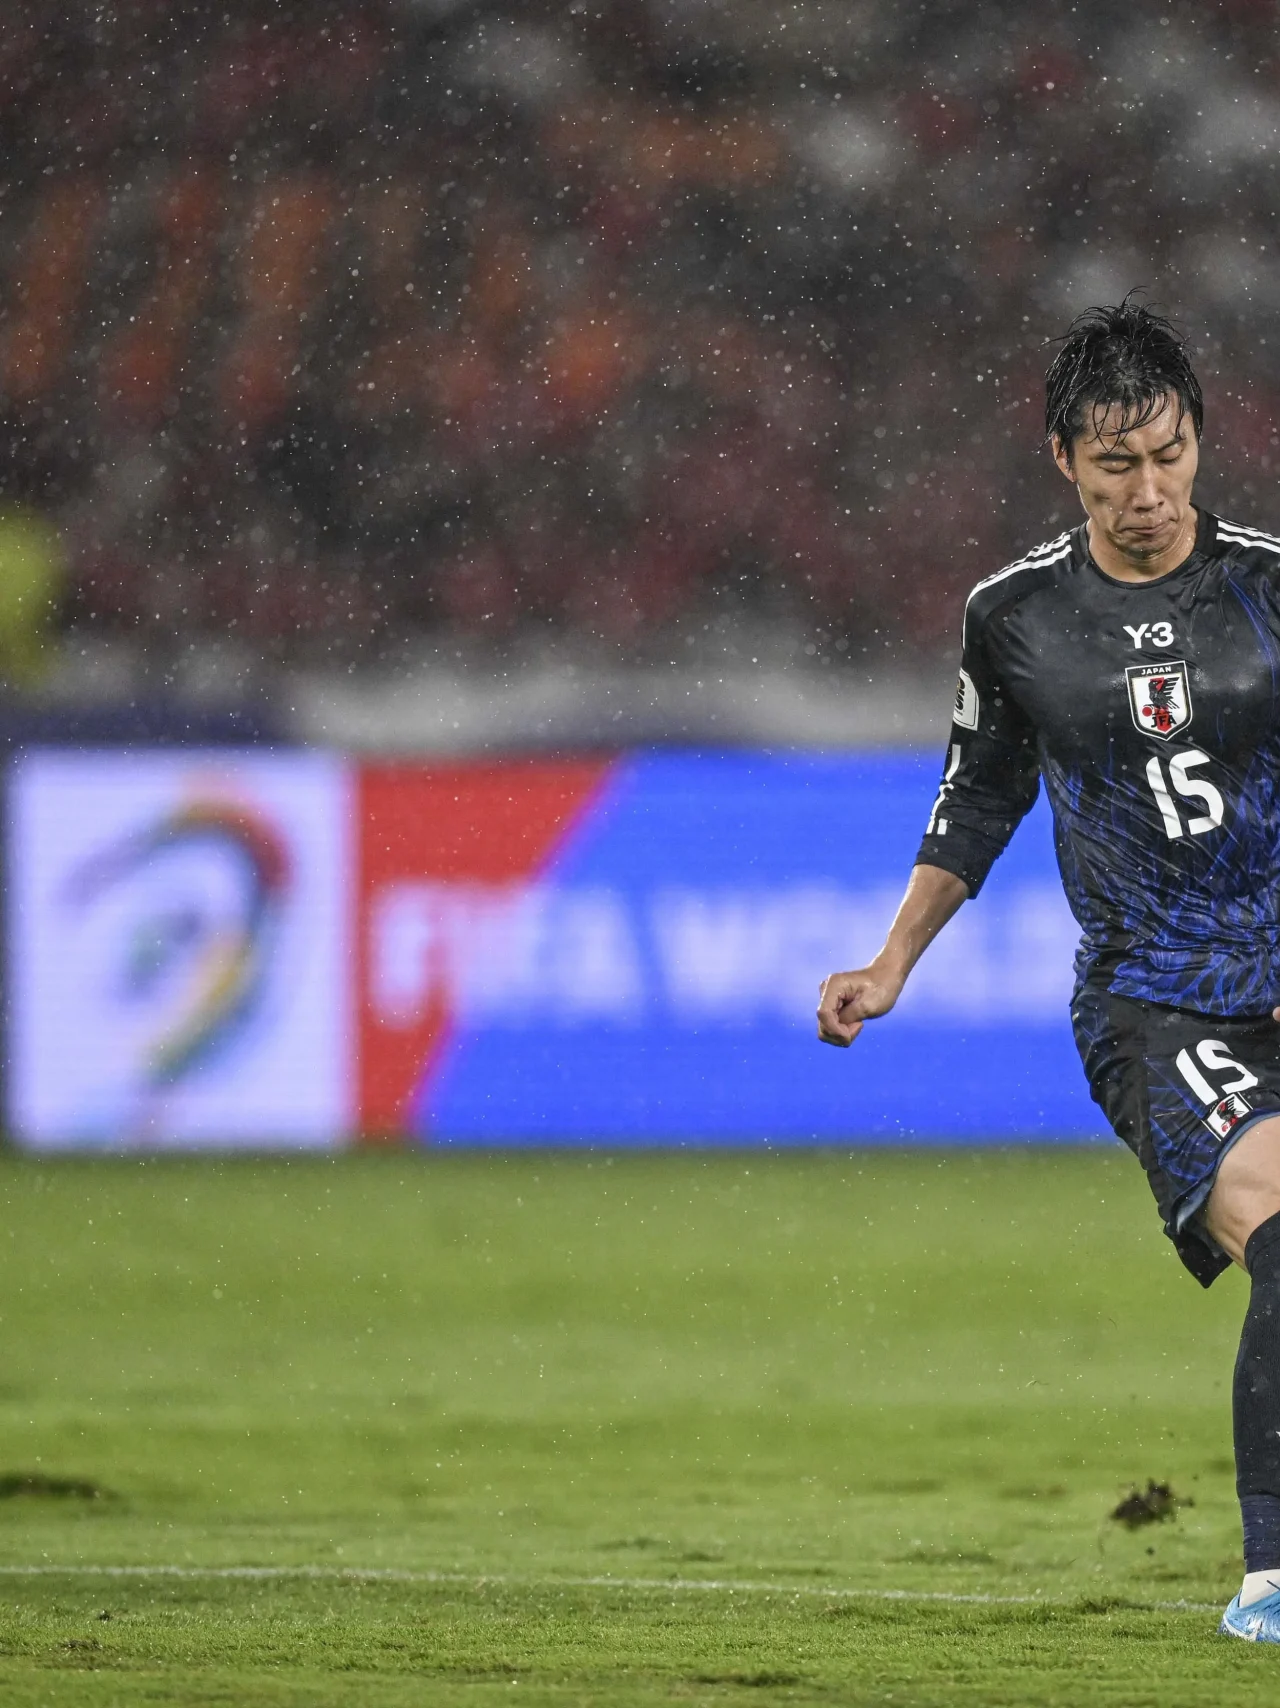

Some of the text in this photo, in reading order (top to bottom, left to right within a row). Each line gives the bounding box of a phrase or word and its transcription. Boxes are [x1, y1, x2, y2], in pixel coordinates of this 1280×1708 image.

[1122, 621, 1175, 649] Y-3
[1141, 665, 1172, 676] JAPAN
[1150, 713, 1178, 728] JFA
[1145, 749, 1224, 839] 15
[1175, 1039, 1259, 1106] 15
